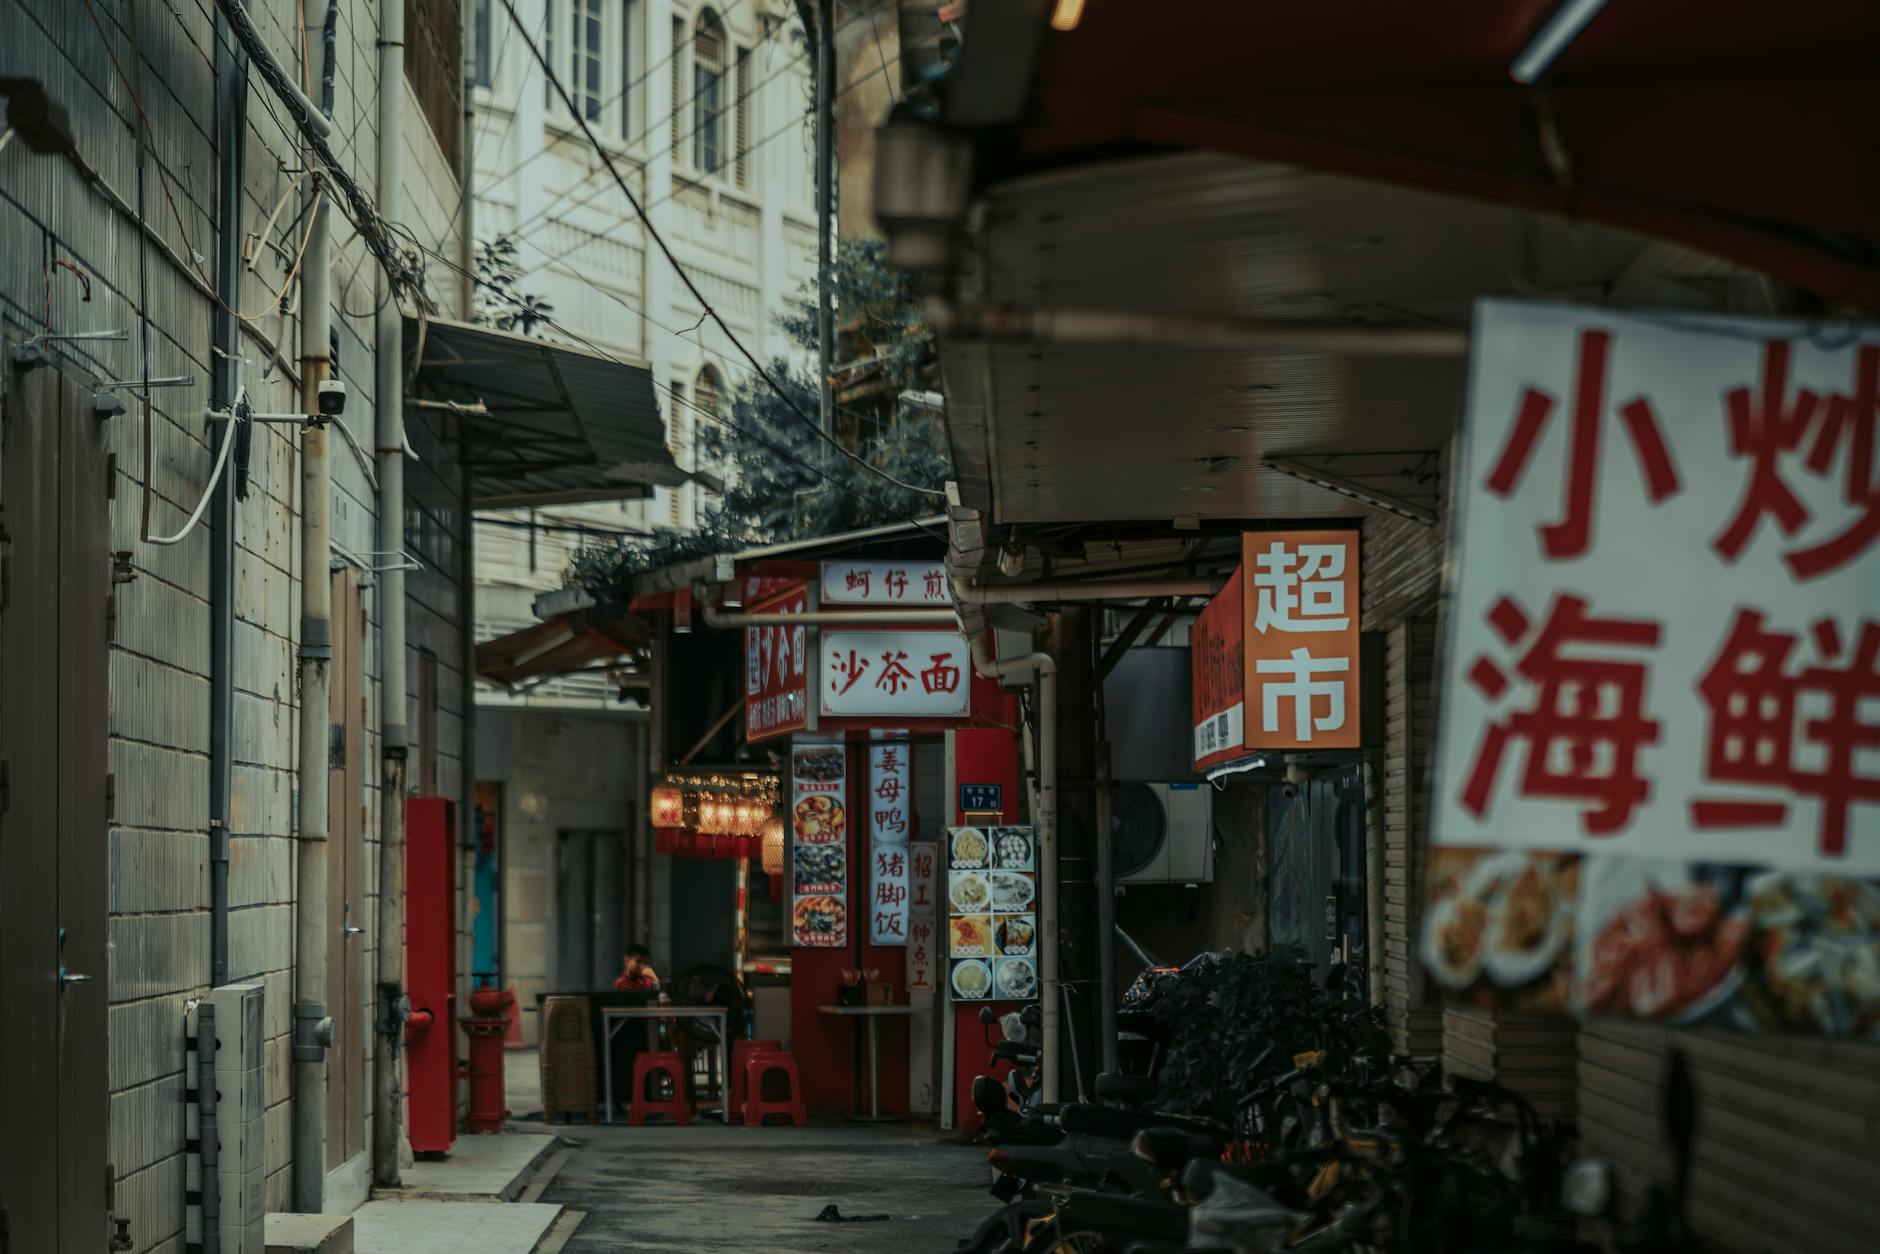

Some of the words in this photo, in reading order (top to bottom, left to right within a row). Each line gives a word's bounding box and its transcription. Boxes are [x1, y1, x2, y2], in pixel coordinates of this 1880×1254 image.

[1481, 326, 1880, 582] 小炒
[831, 649, 961, 697] 沙茶面
[1254, 541, 1351, 742] 超市
[1458, 592, 1880, 857] 海鲜
[874, 747, 906, 835] 姜母鸭
[971, 796, 984, 808] 17
[875, 852, 906, 937] 猪脚饭
[913, 852, 933, 907] 招工
[911, 922, 931, 987] 钟点工
